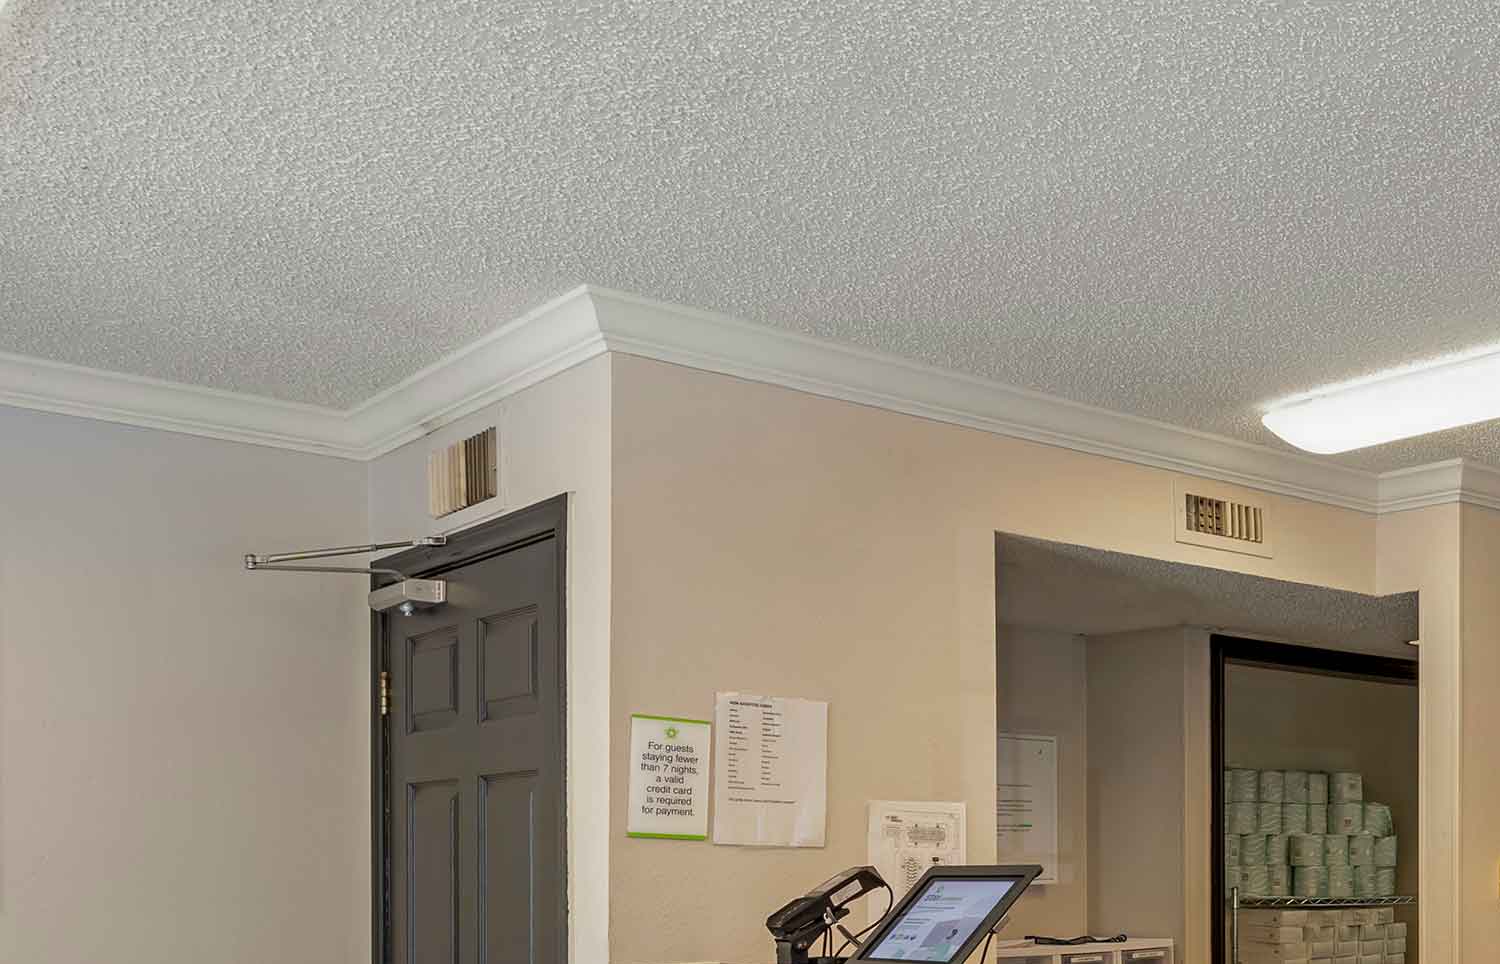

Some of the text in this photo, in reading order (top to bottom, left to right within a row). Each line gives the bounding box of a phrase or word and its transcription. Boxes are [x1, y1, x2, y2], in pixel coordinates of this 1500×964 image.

[648, 741, 694, 753] For guests
[642, 753, 699, 763] staying fewer
[641, 763, 660, 772] than
[663, 764, 669, 772] 7
[664, 775, 684, 784] valid
[646, 785, 692, 795] credit card
[656, 796, 692, 806] required
[641, 806, 695, 816] for payment.
